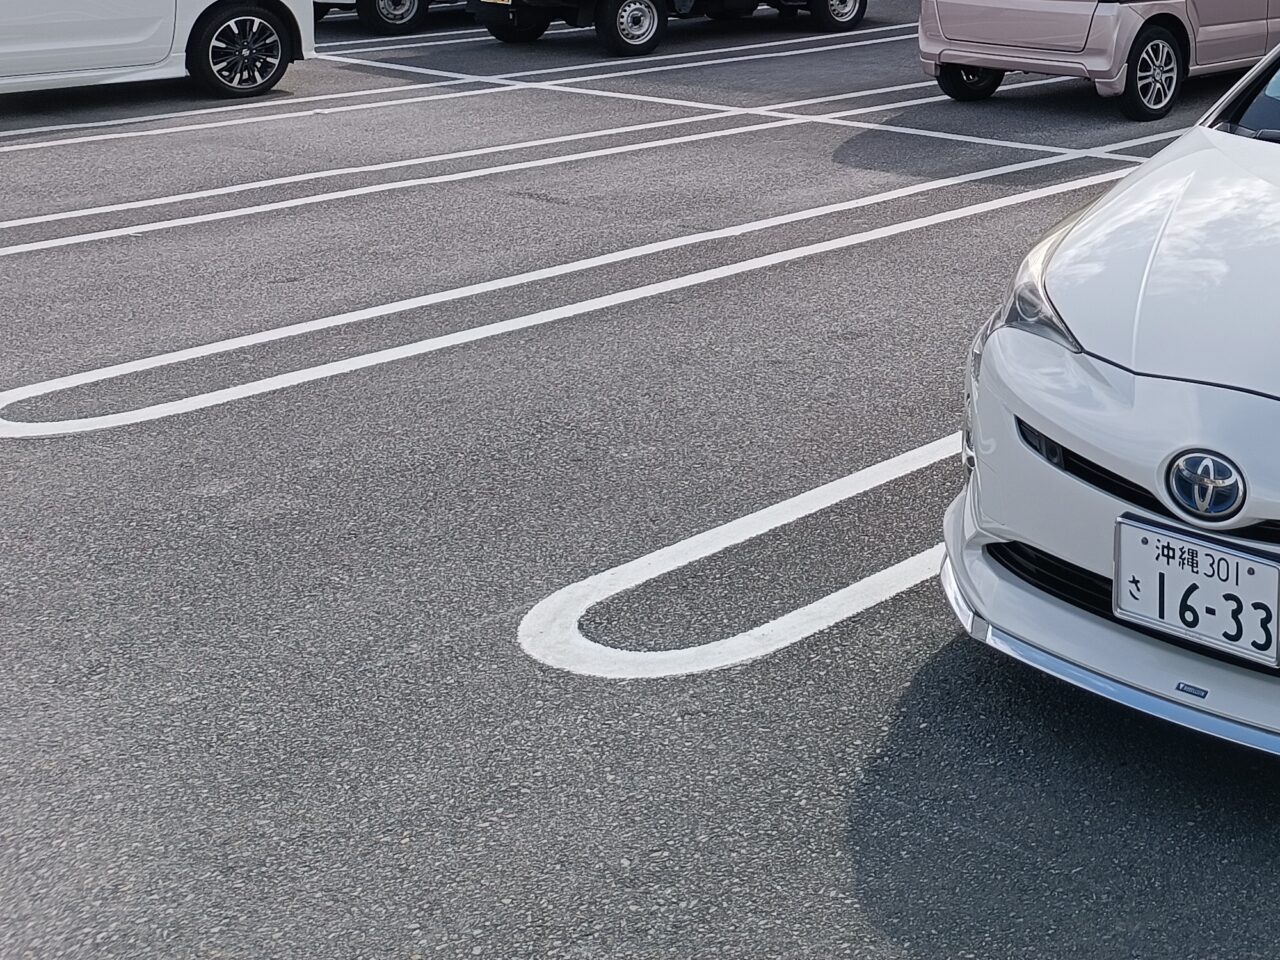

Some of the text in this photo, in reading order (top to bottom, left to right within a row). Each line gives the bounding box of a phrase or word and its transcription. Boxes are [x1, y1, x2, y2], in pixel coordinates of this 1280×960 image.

[1155, 538, 1240, 587] 沖縄301
[1128, 571, 1273, 652] さ 16-33
